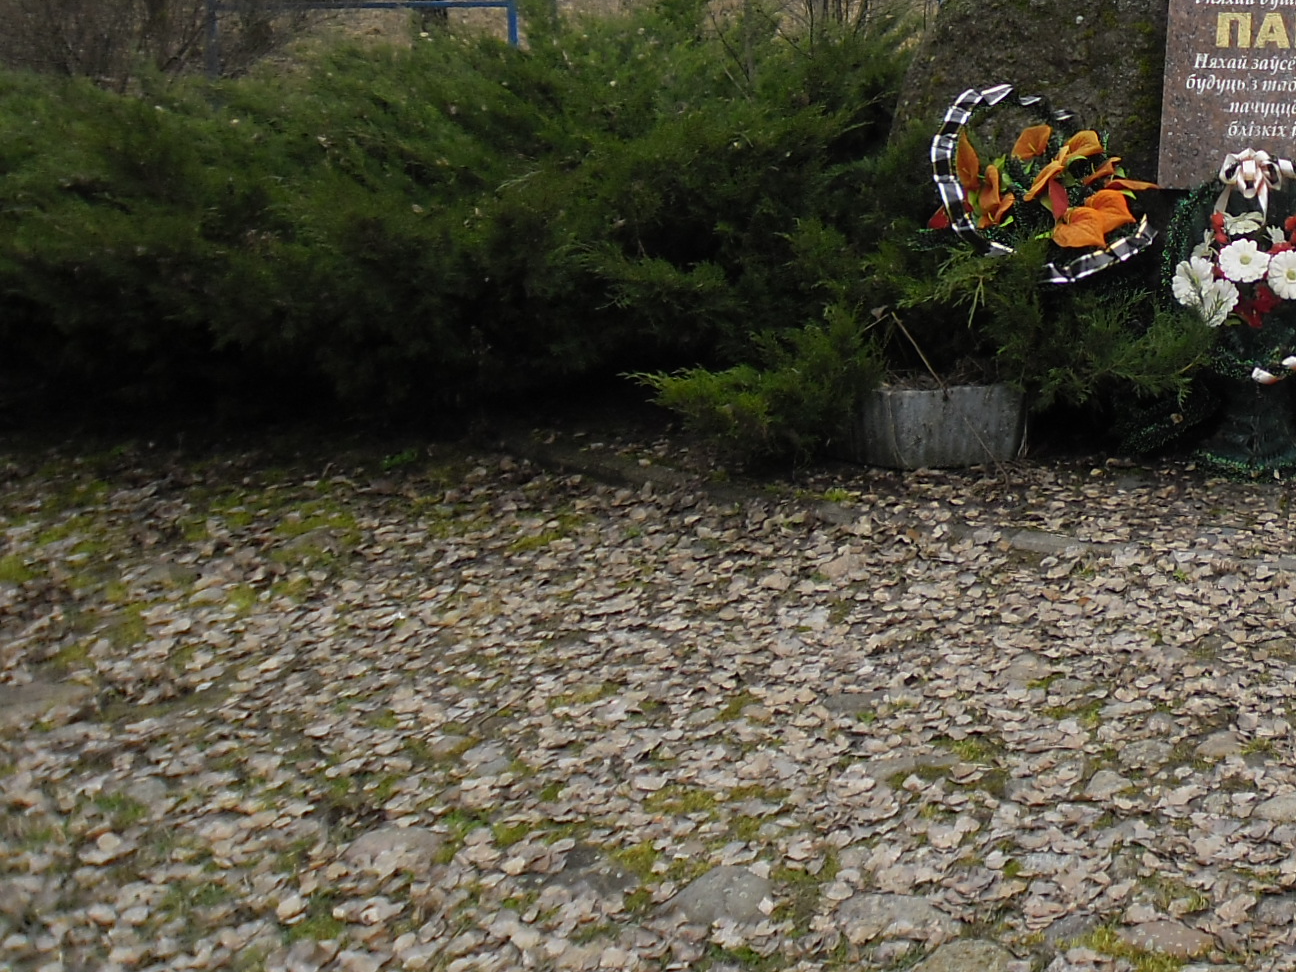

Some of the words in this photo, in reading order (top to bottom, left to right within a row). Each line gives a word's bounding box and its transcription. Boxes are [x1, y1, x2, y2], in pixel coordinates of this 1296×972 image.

[1194, 52, 1248, 70] Няхай
[1185, 73, 1245, 95] будуць
[1250, 79, 1258, 92] з
[1228, 120, 1288, 138] блізкіх
